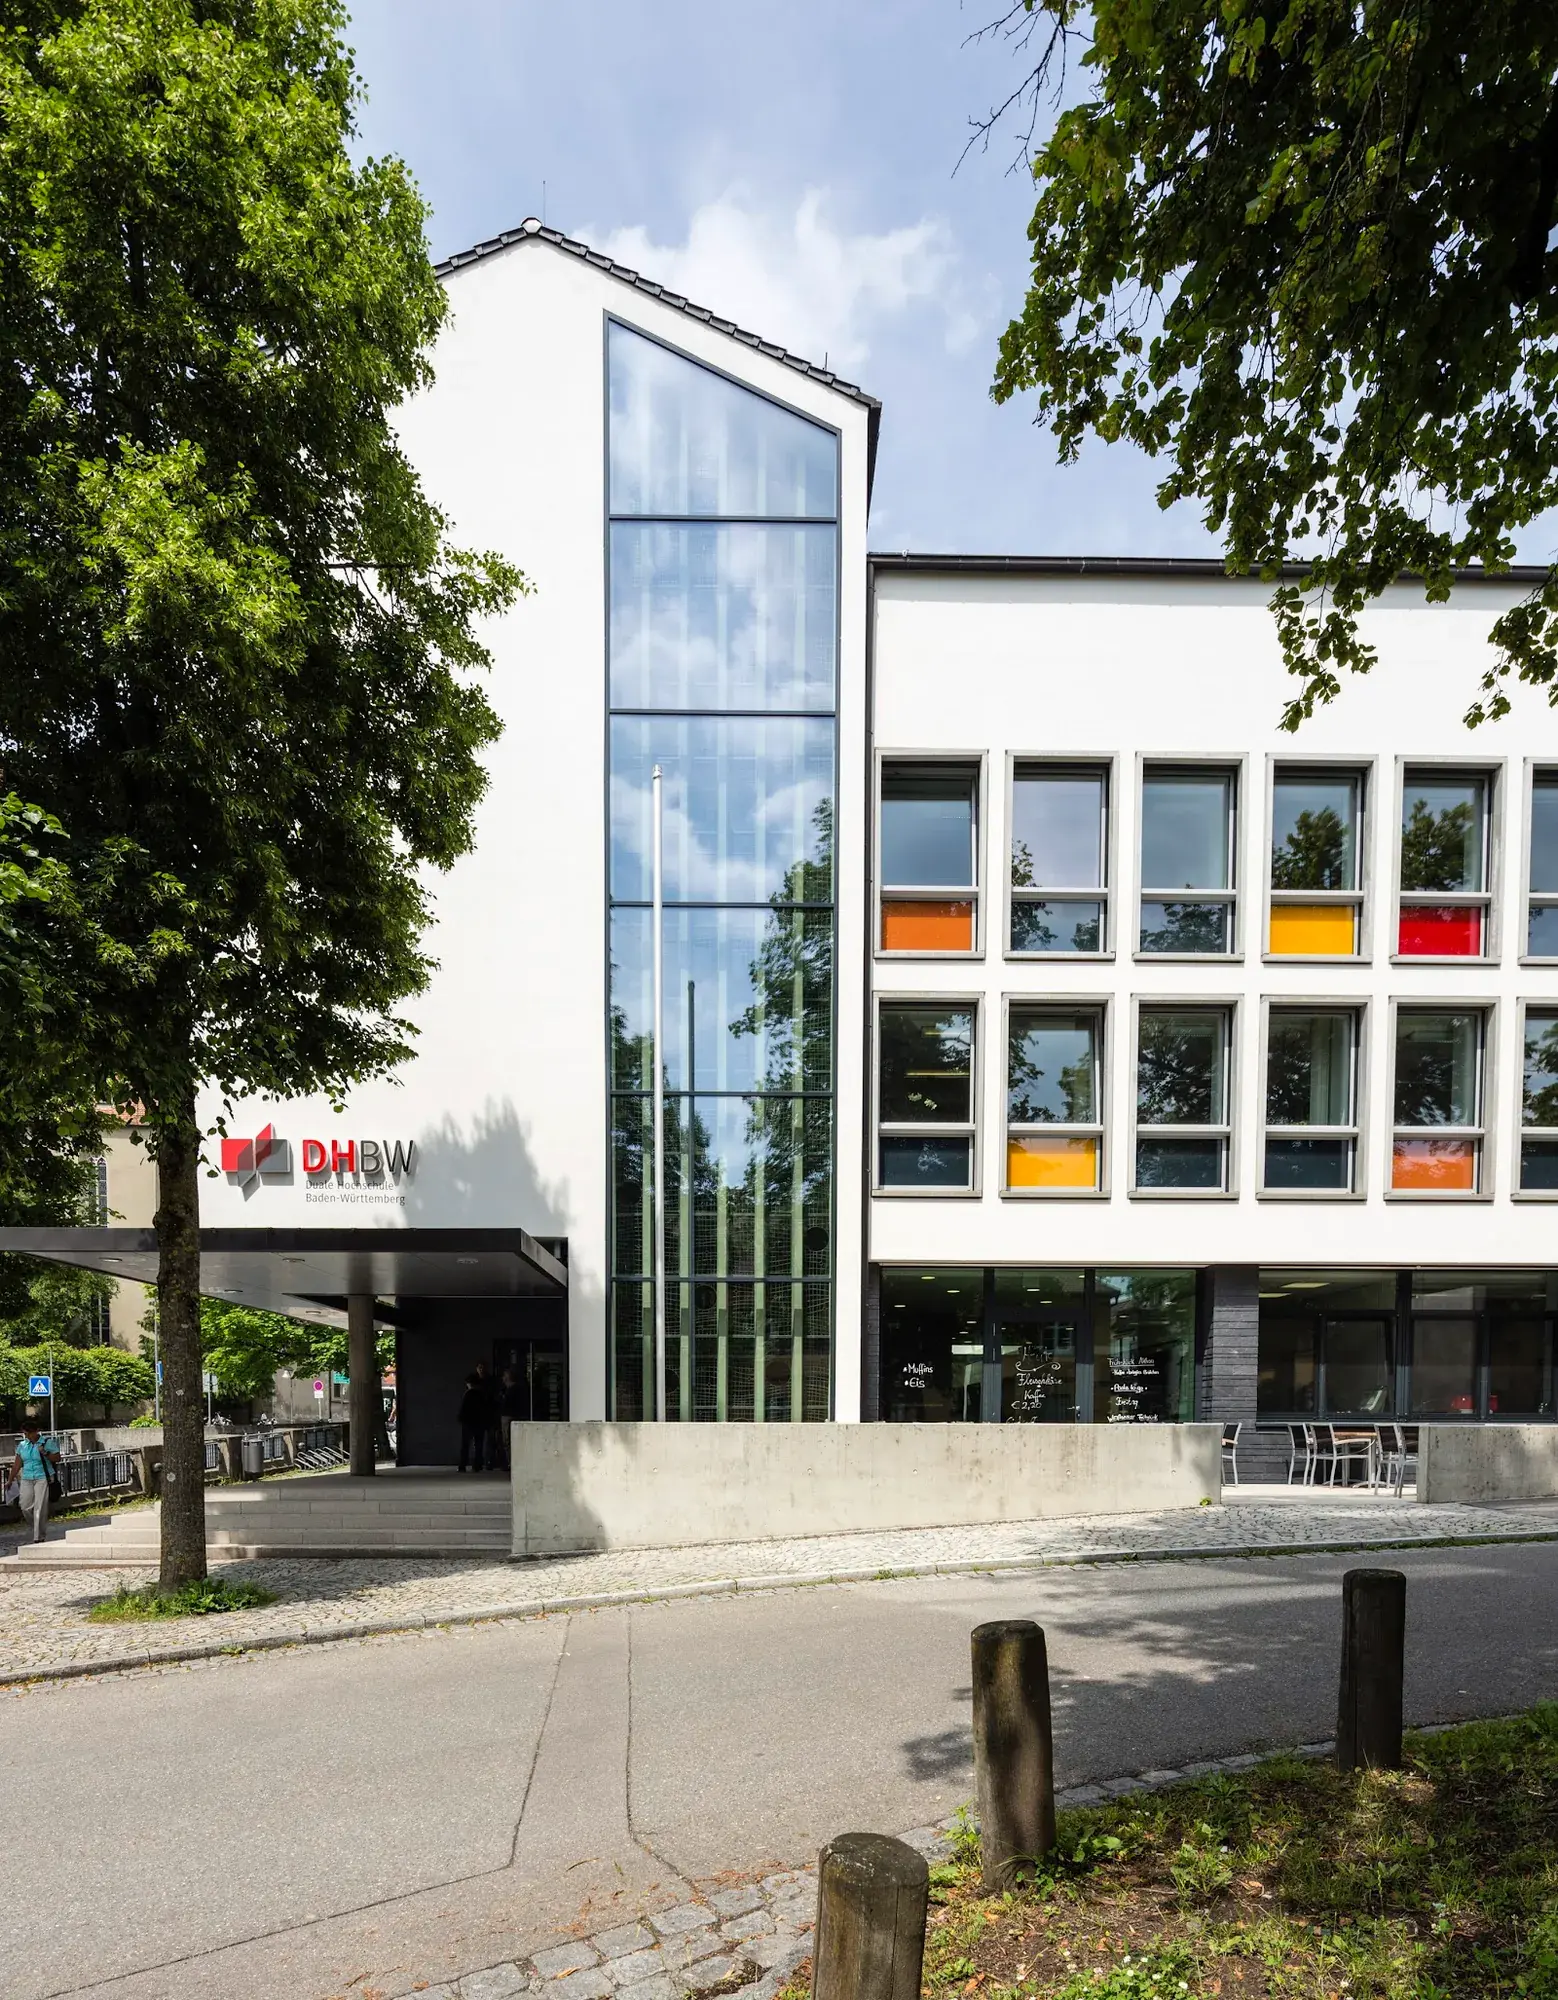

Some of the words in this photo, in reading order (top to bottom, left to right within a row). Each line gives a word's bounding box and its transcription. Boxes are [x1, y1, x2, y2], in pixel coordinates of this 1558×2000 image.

[302, 1139, 415, 1173] DHBW
[305, 1180, 334, 1190] Duale
[337, 1180, 395, 1191] Hochschule
[305, 1193, 406, 1206] Baden-Württemberg
[907, 1363, 934, 1375] Muffins
